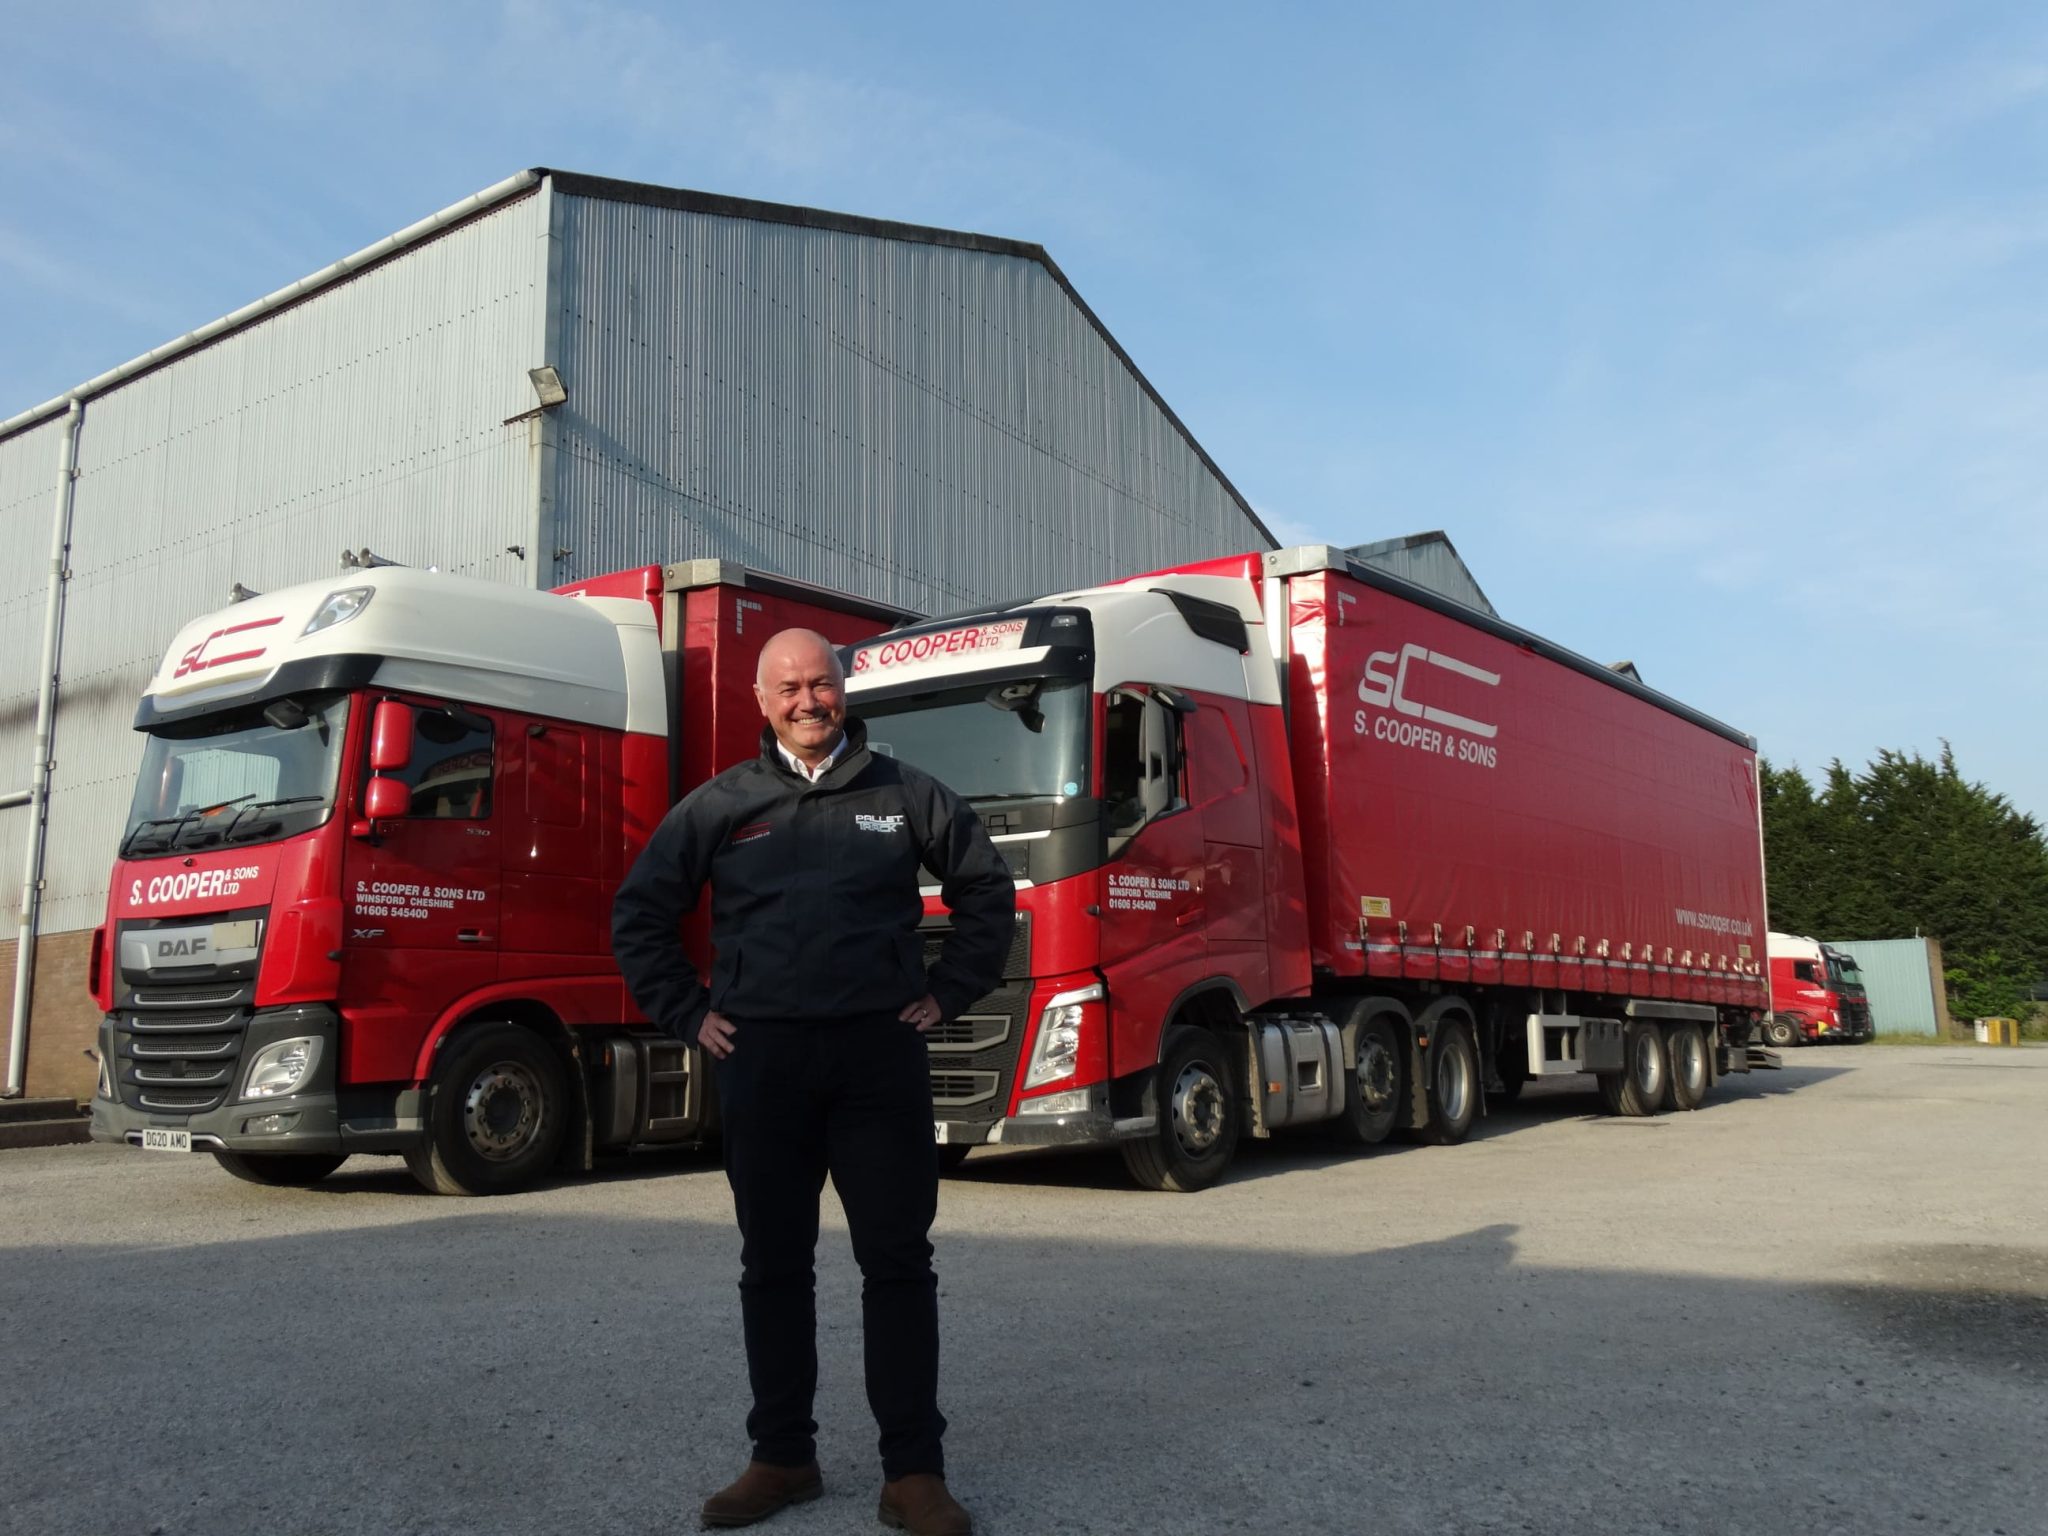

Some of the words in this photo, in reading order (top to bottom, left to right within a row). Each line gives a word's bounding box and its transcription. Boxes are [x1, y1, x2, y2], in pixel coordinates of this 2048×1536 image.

[853, 650, 870, 671] S.
[879, 628, 979, 666] COOPER
[980, 628, 987, 636] &
[991, 622, 1023, 635] SONS
[979, 636, 999, 648] LTD
[1354, 710, 1369, 735] S.
[1375, 716, 1441, 753] COOPER
[1445, 735, 1454, 758] &
[1458, 739, 1497, 768] SONS
[855, 814, 904, 822] PALLET
[129, 879, 143, 906] S.
[148, 869, 224, 903] COOPER
[225, 869, 231, 880] &
[233, 866, 259, 878] SONS
[223, 882, 240, 895] LTD
[1109, 874, 1117, 886] S.
[1118, 875, 1149, 888] COOPER
[1150, 878, 1156, 889] &
[1158, 878, 1177, 890] SONS
[1178, 880, 1190, 891] LTD
[357, 881, 368, 892] S.
[372, 882, 420, 896] COOPER
[422, 886, 431, 897] &
[434, 887, 464, 899] SONS
[466, 890, 486, 901] LTD
[1109, 887, 1141, 898] WINSFORD
[1143, 889, 1171, 900] CHESHIRE
[356, 893, 405, 905] WINSFORD
[410, 897, 455, 909] CHESHIRE
[1109, 898, 1131, 909] 01606
[1132, 900, 1156, 910] 545400
[355, 905, 388, 916] 01606
[391, 907, 428, 918] 545400
[1675, 907, 1753, 937] www.scooper.co.uk
[351, 928, 385, 939] XF
[157, 938, 207, 957] DAF
